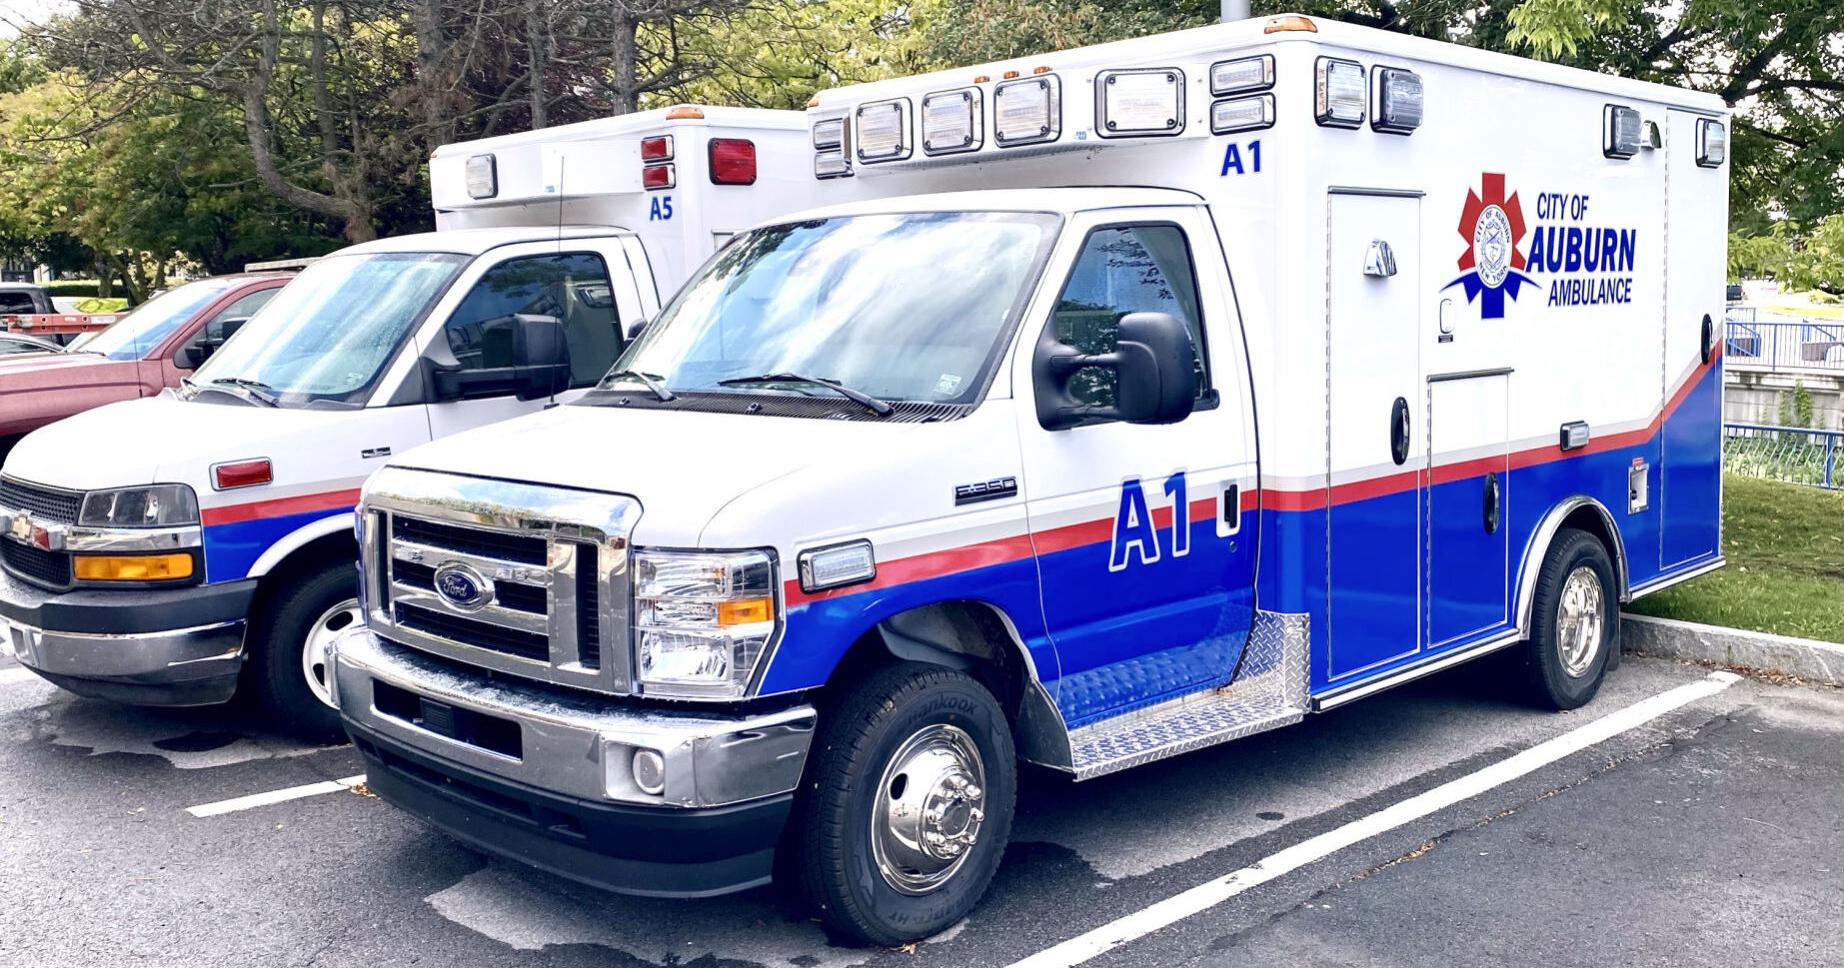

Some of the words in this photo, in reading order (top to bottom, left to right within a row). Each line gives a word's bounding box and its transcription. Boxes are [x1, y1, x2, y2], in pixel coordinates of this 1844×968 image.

[1220, 139, 1261, 177] A1
[650, 195, 673, 221] A5
[1537, 192, 1569, 220] CITY
[1571, 194, 1589, 221] OF
[1525, 226, 1637, 273] AUBURN
[1492, 265, 1508, 283] YORK
[1547, 277, 1633, 307] AMBULANCE
[1109, 468, 1191, 573] A1
[442, 575, 469, 598] Ford
